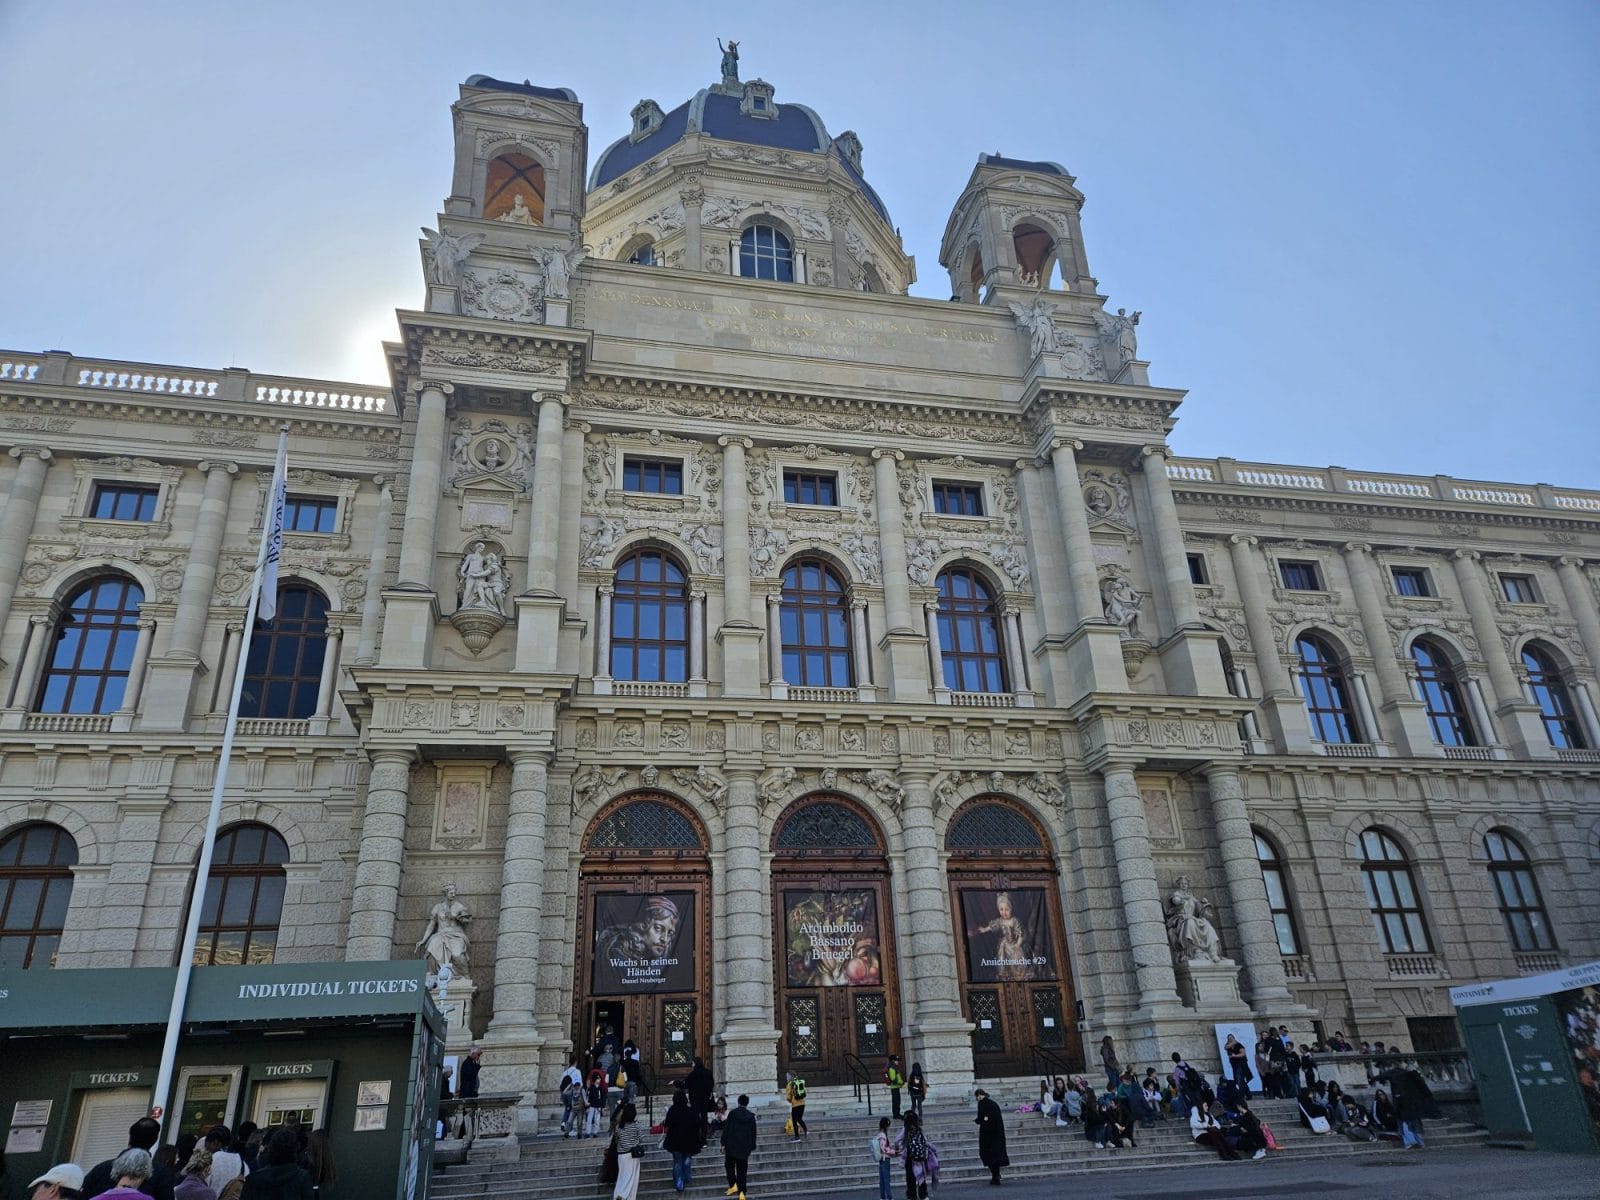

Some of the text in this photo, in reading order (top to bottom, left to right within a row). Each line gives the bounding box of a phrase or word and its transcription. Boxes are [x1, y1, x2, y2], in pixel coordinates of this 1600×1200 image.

[810, 936, 855, 947] Bassano
[812, 948, 854, 962] Bruegel
[609, 957, 678, 968] Wachs in seinen
[627, 967, 661, 977] Händen
[238, 979, 418, 999] INDIVIDUAL TICKETS
[1503, 1005, 1540, 1017] TICKETS
[266, 1063, 313, 1076] TICKETS
[89, 1072, 140, 1084] TICKETS
